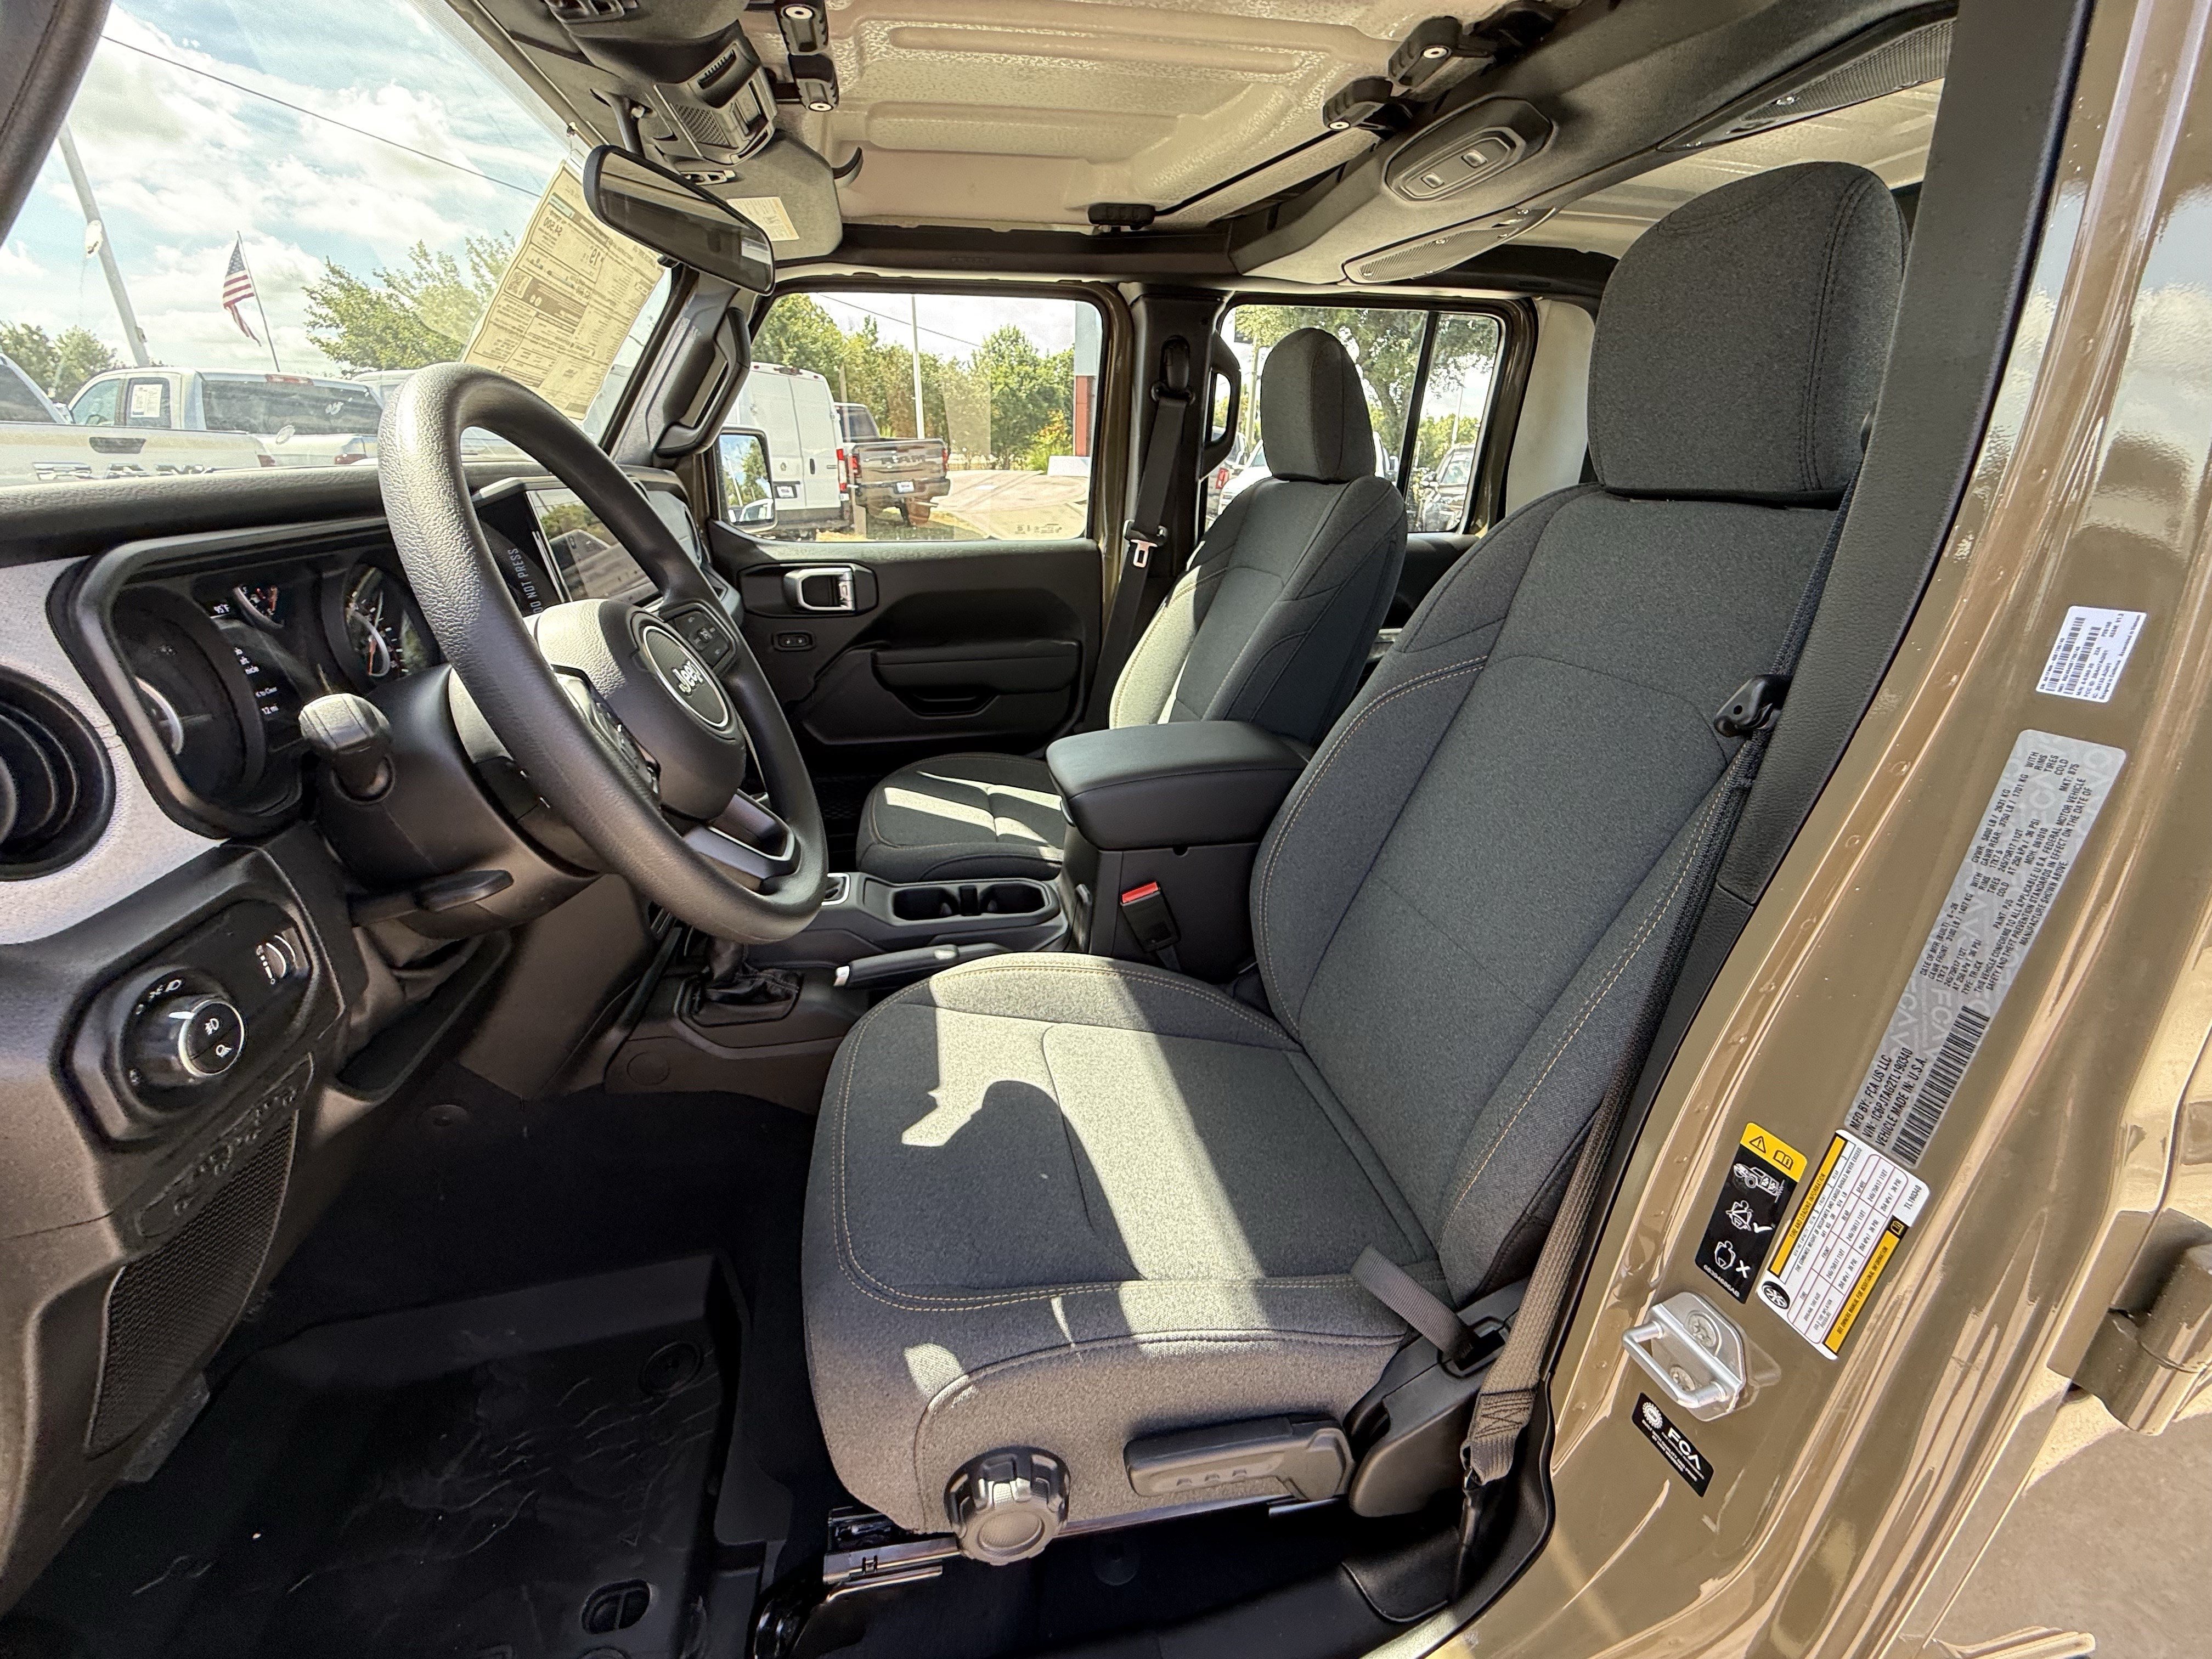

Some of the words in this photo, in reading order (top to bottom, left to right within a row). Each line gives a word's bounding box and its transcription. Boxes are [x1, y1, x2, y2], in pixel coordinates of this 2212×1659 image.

[507, 548, 529, 578] PRESS
[521, 581, 538, 599] NOT
[530, 601, 543, 613] DO
[672, 661, 703, 693] Jeep
[2024, 751, 2039, 768] WITH
[2034, 754, 2049, 770] RIMS
[2043, 754, 2059, 773] TIRES
[2053, 758, 2069, 775] COLD
[2000, 788, 2011, 798] KG
[2066, 777, 2086, 803] VEHICLE
[2080, 786, 2094, 796] OF
[1994, 798, 2007, 812] 2631
[2072, 797, 2088, 814] DATE
[1979, 848, 1994, 866] GAWR
[1997, 812, 2011, 827] 3750
[2004, 804, 2015, 812] LB
[2011, 783, 2025, 797] 1701
[2018, 773, 2030, 783] KG
[1987, 818, 1997, 827] LB
[2055, 803, 2073, 826] MOTOR
[2066, 814, 2080, 827] THE
[2028, 818, 2040, 830] PSI
[2061, 827, 2073, 837] ON
[1980, 827, 1994, 841] 5800
[2024, 829, 2035, 838] 36
[2031, 827, 2049, 848] 061010
[2041, 826, 2062, 854] FEDERAL
[1996, 843, 2017, 872] 245/75R17
[2011, 828, 2024, 842] 112T
[2016, 843, 2028, 855] kPa
[2049, 837, 2068, 860] EFFECT
[2011, 855, 2023, 866] 250
[2045, 860, 2057, 868] IN
[1970, 871, 1983, 888] WITH
[2006, 866, 2017, 876] AT
[1978, 875, 1991, 890] RIMS
[1987, 876, 2001, 894] TIRES
[1996, 881, 2010, 898] COLD
[2015, 872, 2039, 907] APPLICABLE
[2028, 867, 2053, 904] STANDARDS
[2009, 907, 2022, 919] ALL
[2011, 902, 2035, 939] PREVENTION
[2018, 903, 2047, 946] MANUFACTURE
[2040, 881, 2058, 904] SHOWN
[2005, 918, 2016, 928] TO
[1927, 962, 1940, 980] GAWR
[1963, 892, 1973, 901] KG
[1990, 927, 2012, 958] CONFORMS
[1929, 940, 1941, 953] MFR
[2002, 938, 2017, 957] THEFT
[1926, 953, 1935, 962] OF
[1951, 982, 1961, 991] AT
[1971, 938, 1982, 950] PSI
[1995, 956, 2008, 970] AND
[1919, 960, 1931, 976] DATE
[1943, 960, 1961, 987] 245/75R17
[1956, 947, 1967, 960] 112T
[1968, 960, 1983, 979] TRUCK
[1979, 957, 1997, 980] VEHICLE
[1973, 979, 1986, 994] THIS
[1985, 969, 2002, 991] SAFETY
[1876, 1053, 1892, 1071] LLC
[1906, 1053, 1927, 1081] U.S.A.
[1869, 1046, 1913, 1123] 1C6PJTAG2TL190340
[1871, 1068, 1885, 1083] US
[1864, 1080, 1879, 1099] FCA
[1900, 1077, 1915, 1094] IN:
[1857, 1096, 1871, 1113] BY:
[1889, 1091, 1909, 1117] MADE
[1849, 1110, 1865, 1131] MFD
[1861, 1119, 1878, 1140] VIN:
[1875, 1113, 1898, 1148] VEHICLE
[1806, 1172, 1827, 1202] INFORMATION
[1903, 1183, 1922, 1210] TL190340
[1797, 1200, 1813, 1221] LOADING
[1793, 1218, 1803, 1229] AND
[1667, 1427, 1701, 1471] FCA
